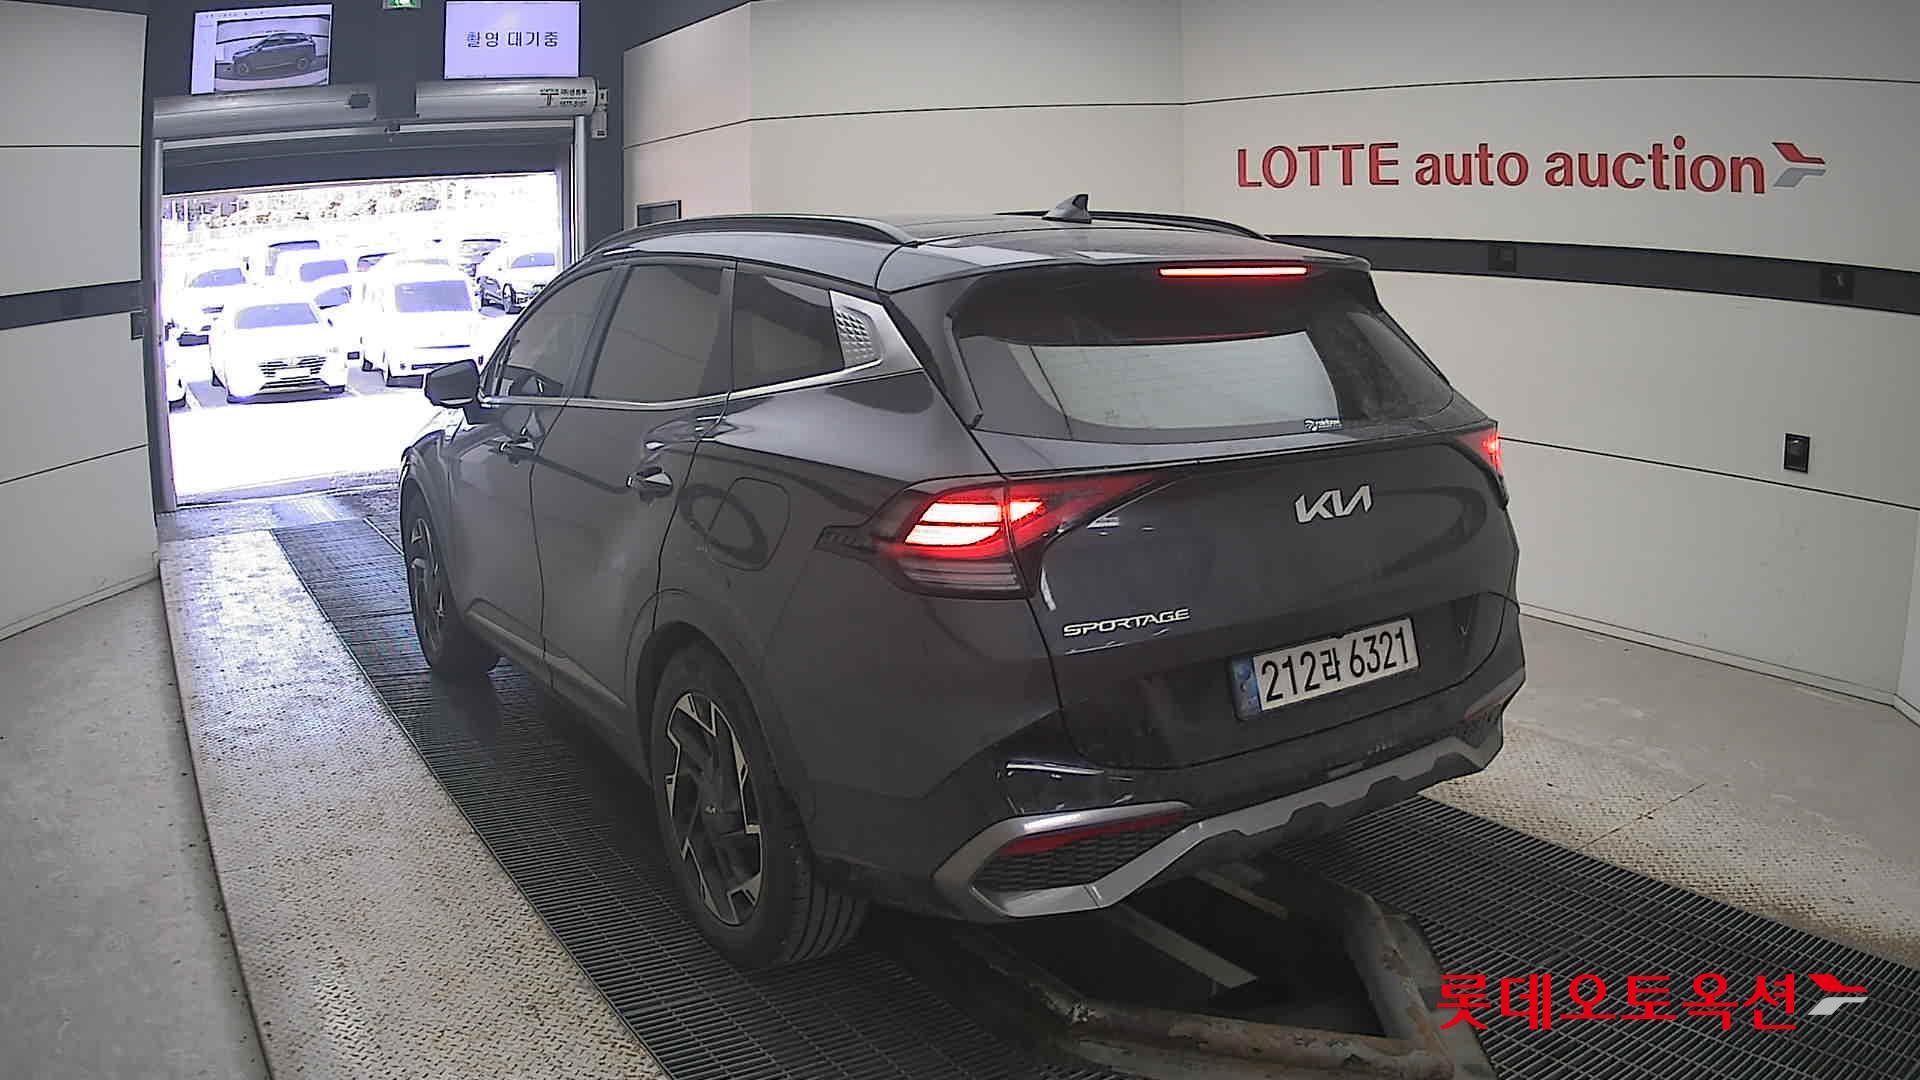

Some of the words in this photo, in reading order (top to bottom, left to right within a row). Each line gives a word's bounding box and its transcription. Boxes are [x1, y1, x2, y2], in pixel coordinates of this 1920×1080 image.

[507, 31, 559, 48] 대기중
[1237, 142, 1400, 188] LOTTE
[1415, 143, 1529, 187] auto
[1544, 135, 1767, 195] auction
[1295, 485, 1372, 523] KIA
[1063, 608, 1191, 637] SPORTAGE
[1261, 648, 1341, 702] 212라
[1350, 626, 1409, 678] 6321
